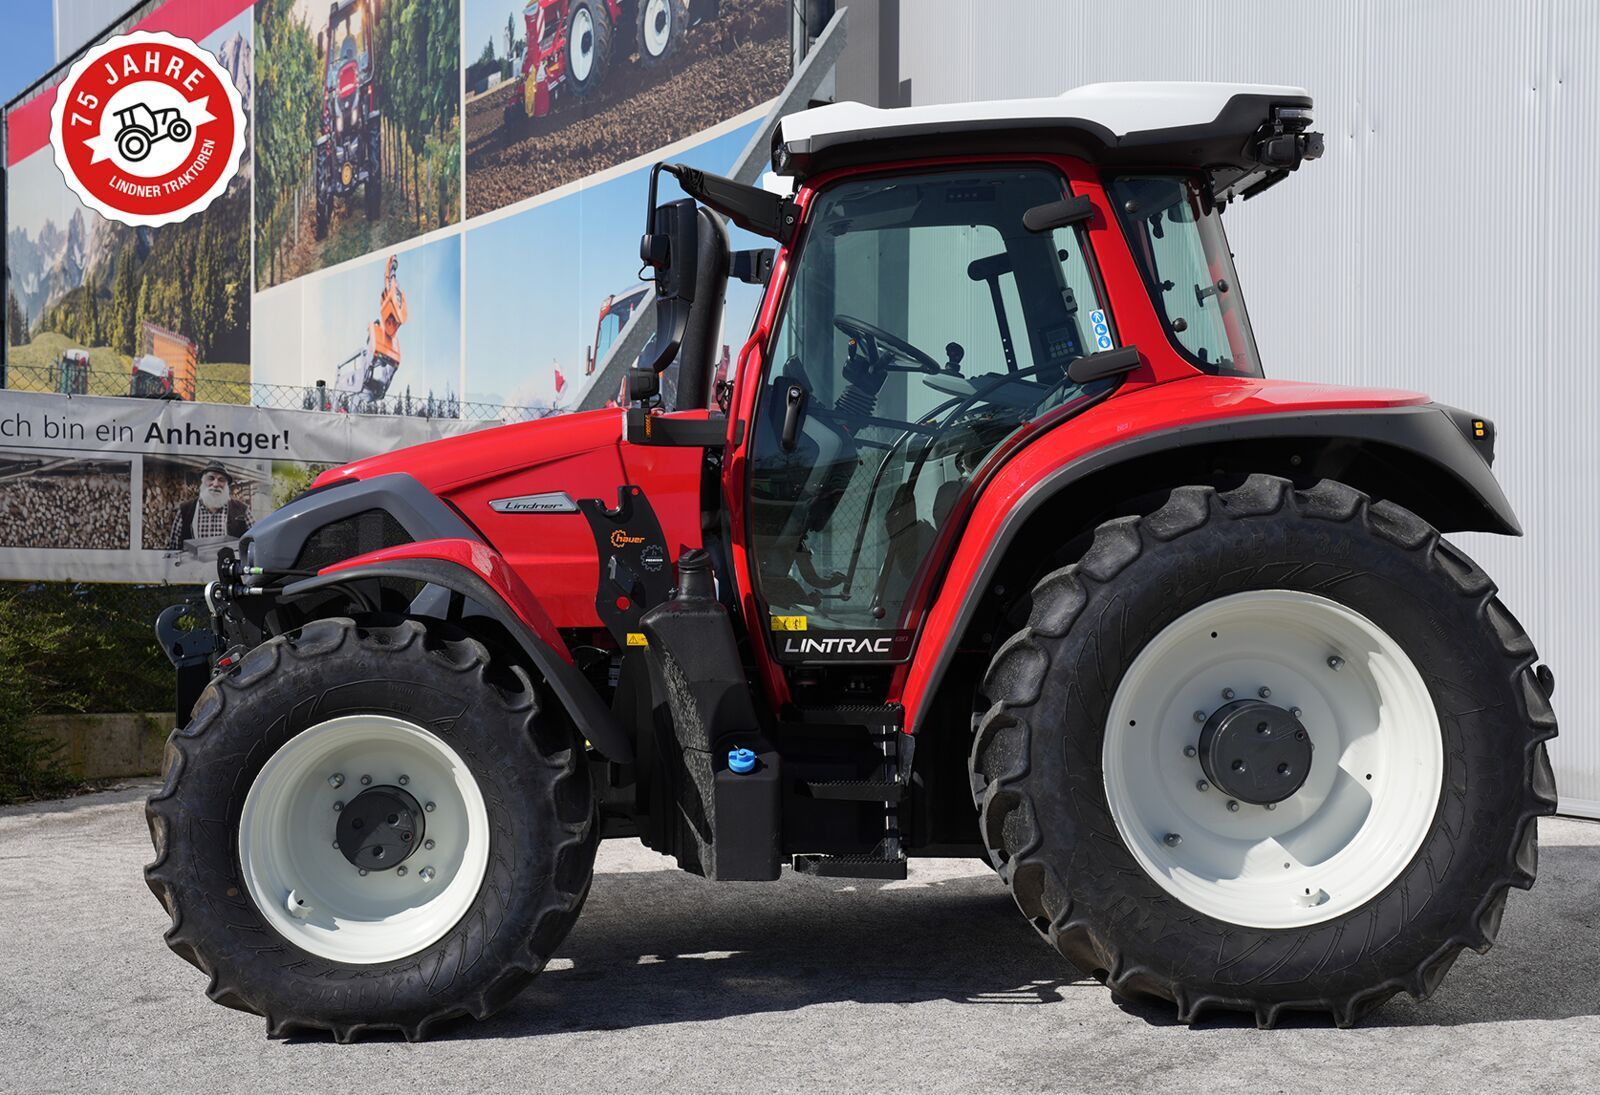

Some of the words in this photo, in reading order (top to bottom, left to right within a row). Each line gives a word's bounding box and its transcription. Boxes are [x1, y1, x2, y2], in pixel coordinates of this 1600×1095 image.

[44, 414, 85, 440] bin
[95, 419, 134, 443] ein
[144, 421, 290, 455] Anhänger!
[505, 502, 563, 510] Lindner
[784, 637, 892, 654] LINTRAC
